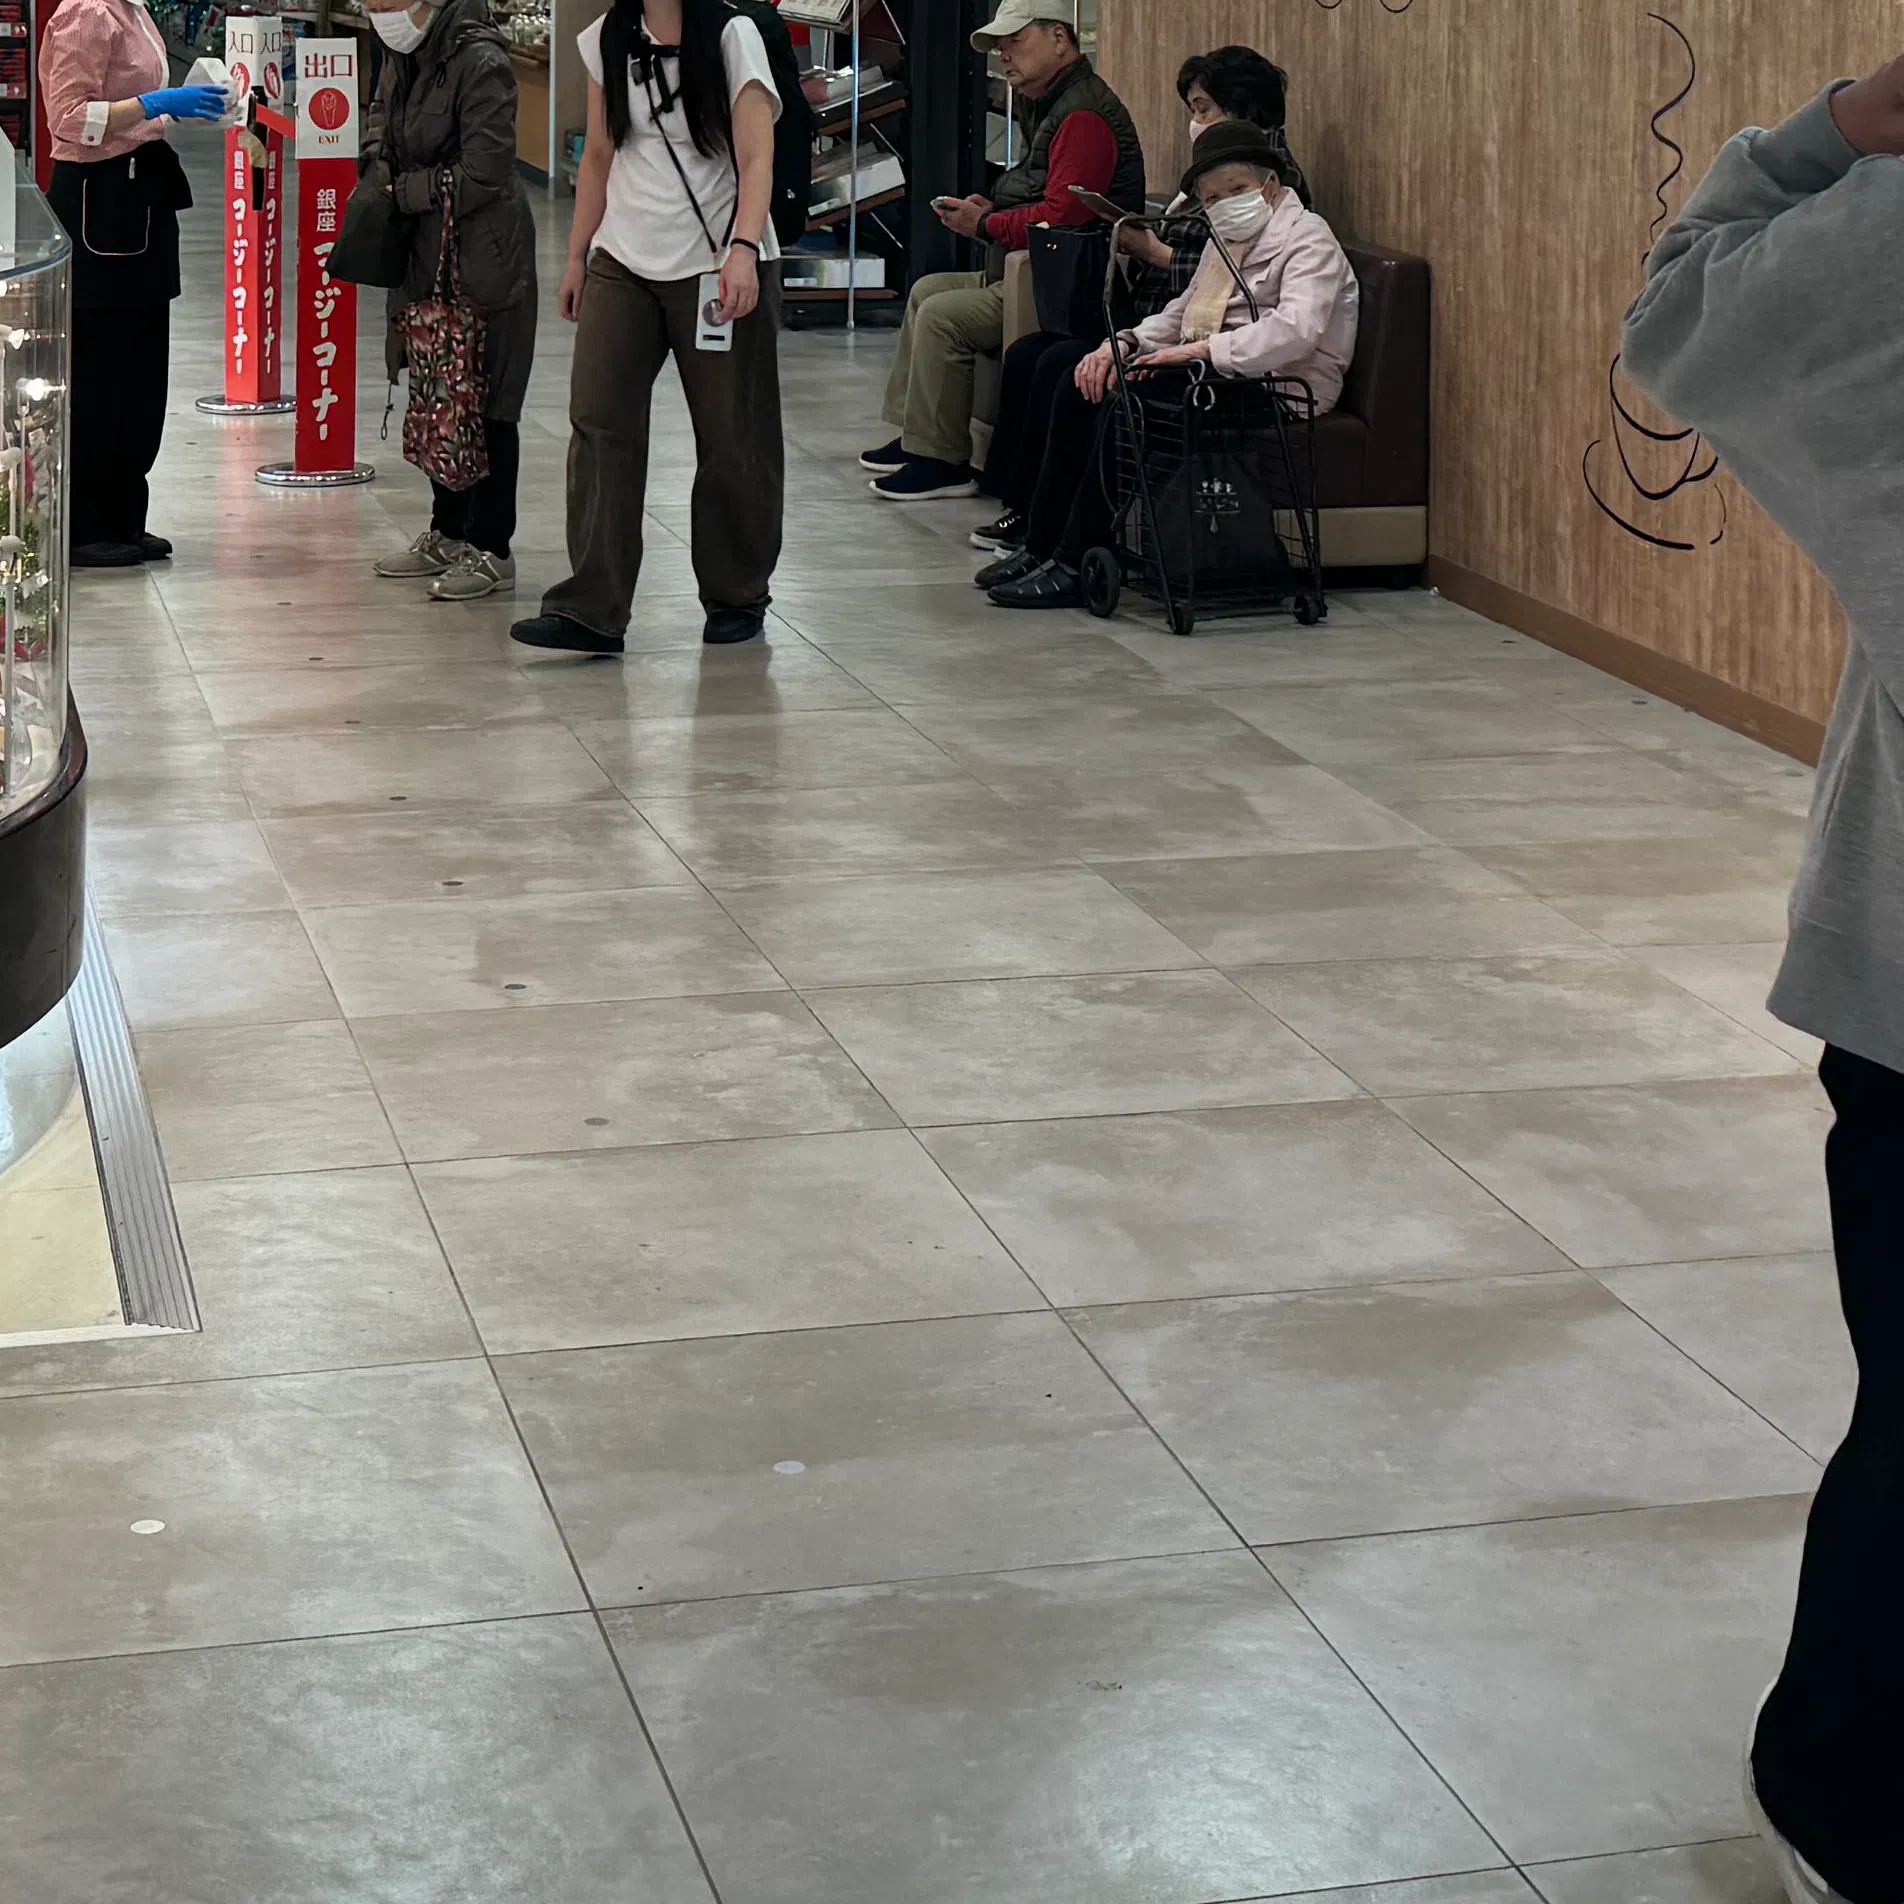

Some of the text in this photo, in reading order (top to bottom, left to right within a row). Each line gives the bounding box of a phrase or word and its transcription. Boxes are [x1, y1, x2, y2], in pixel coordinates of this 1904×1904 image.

[228, 31, 254, 54] 入口
[260, 31, 282, 55] 入口
[304, 53, 353, 79] 出口
[318, 134, 340, 145] EXIT
[316, 188, 336, 233] 銀座
[232, 150, 249, 375] 銀座 コージーコーナー
[263, 197, 277, 375] コージーコーナー
